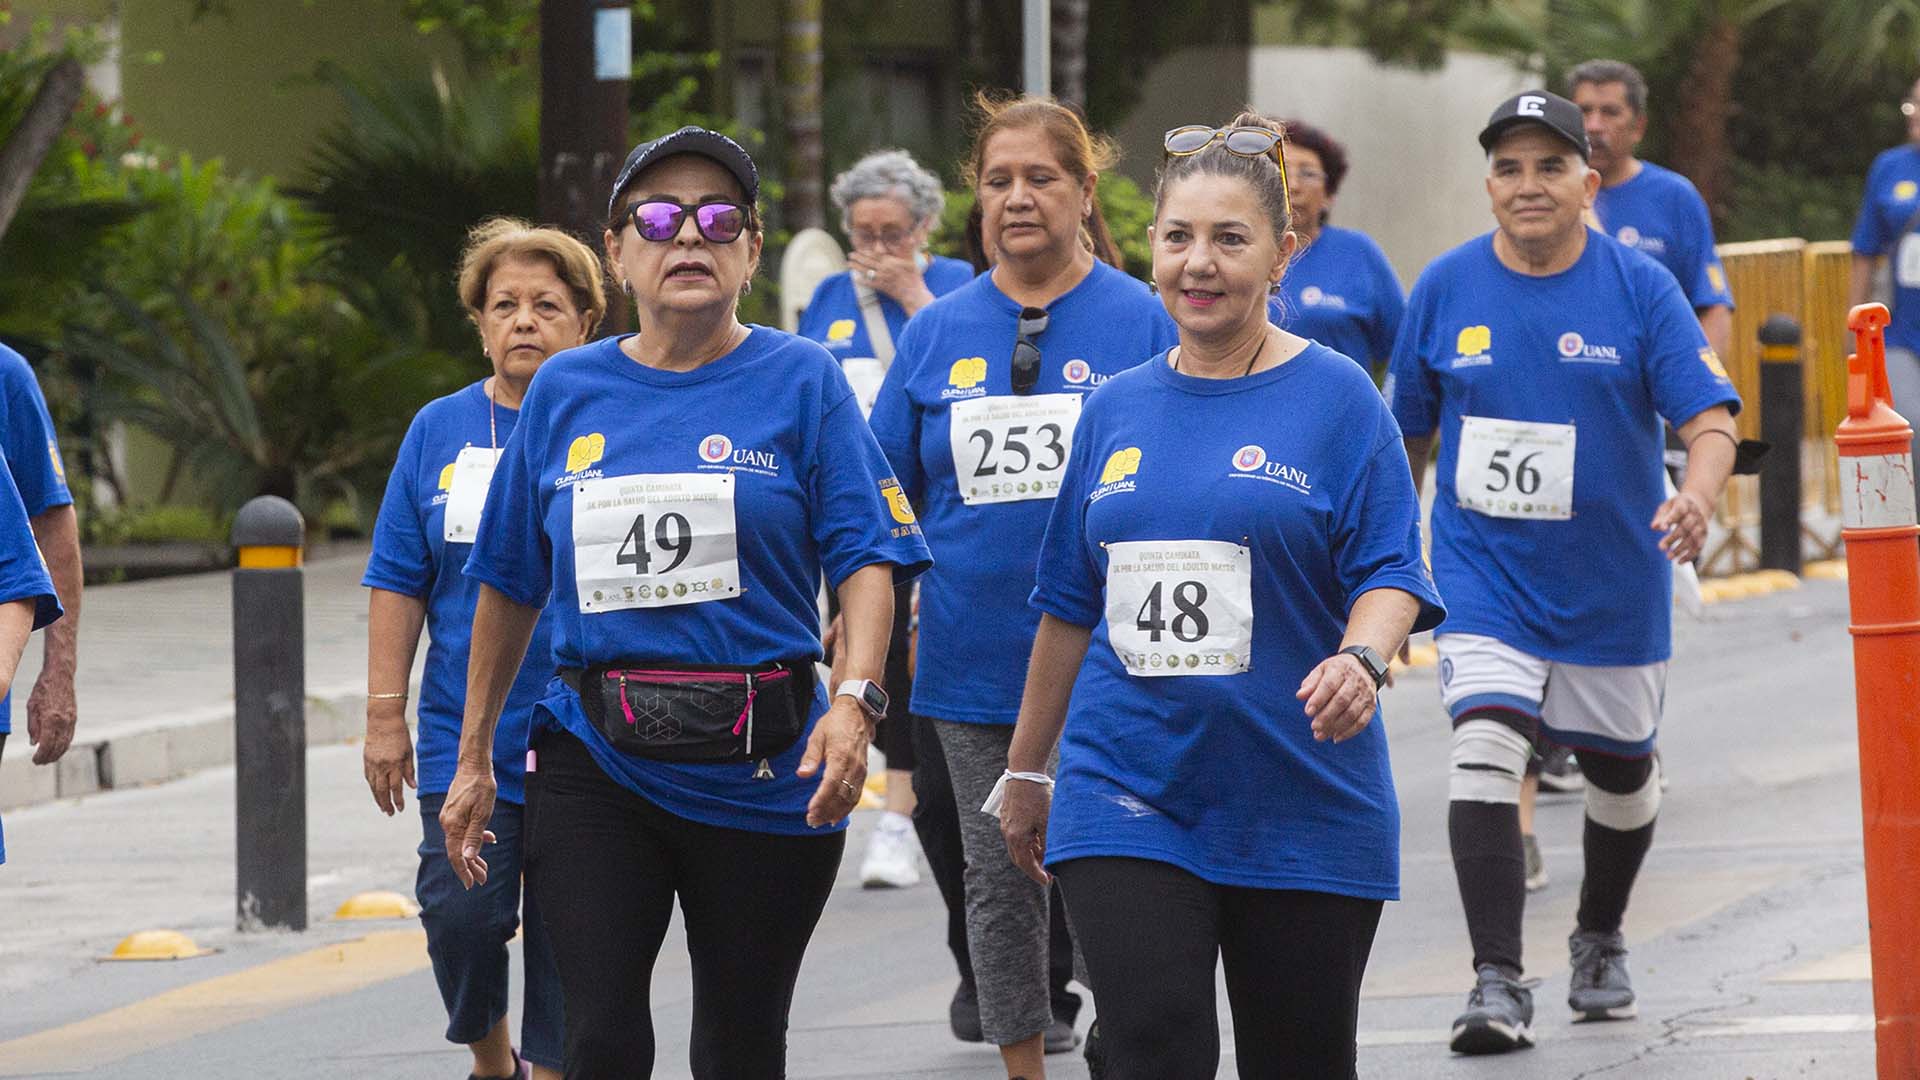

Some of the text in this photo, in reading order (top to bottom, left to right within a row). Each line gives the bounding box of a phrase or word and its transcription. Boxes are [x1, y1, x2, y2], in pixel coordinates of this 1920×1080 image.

[1517, 95, 1547, 117] E
[733, 449, 780, 470] UANL
[968, 423, 1065, 477] 253
[1486, 450, 1544, 495] 56
[1265, 461, 1312, 489] UANL
[616, 512, 692, 575] 49
[1136, 580, 1209, 643] 48
